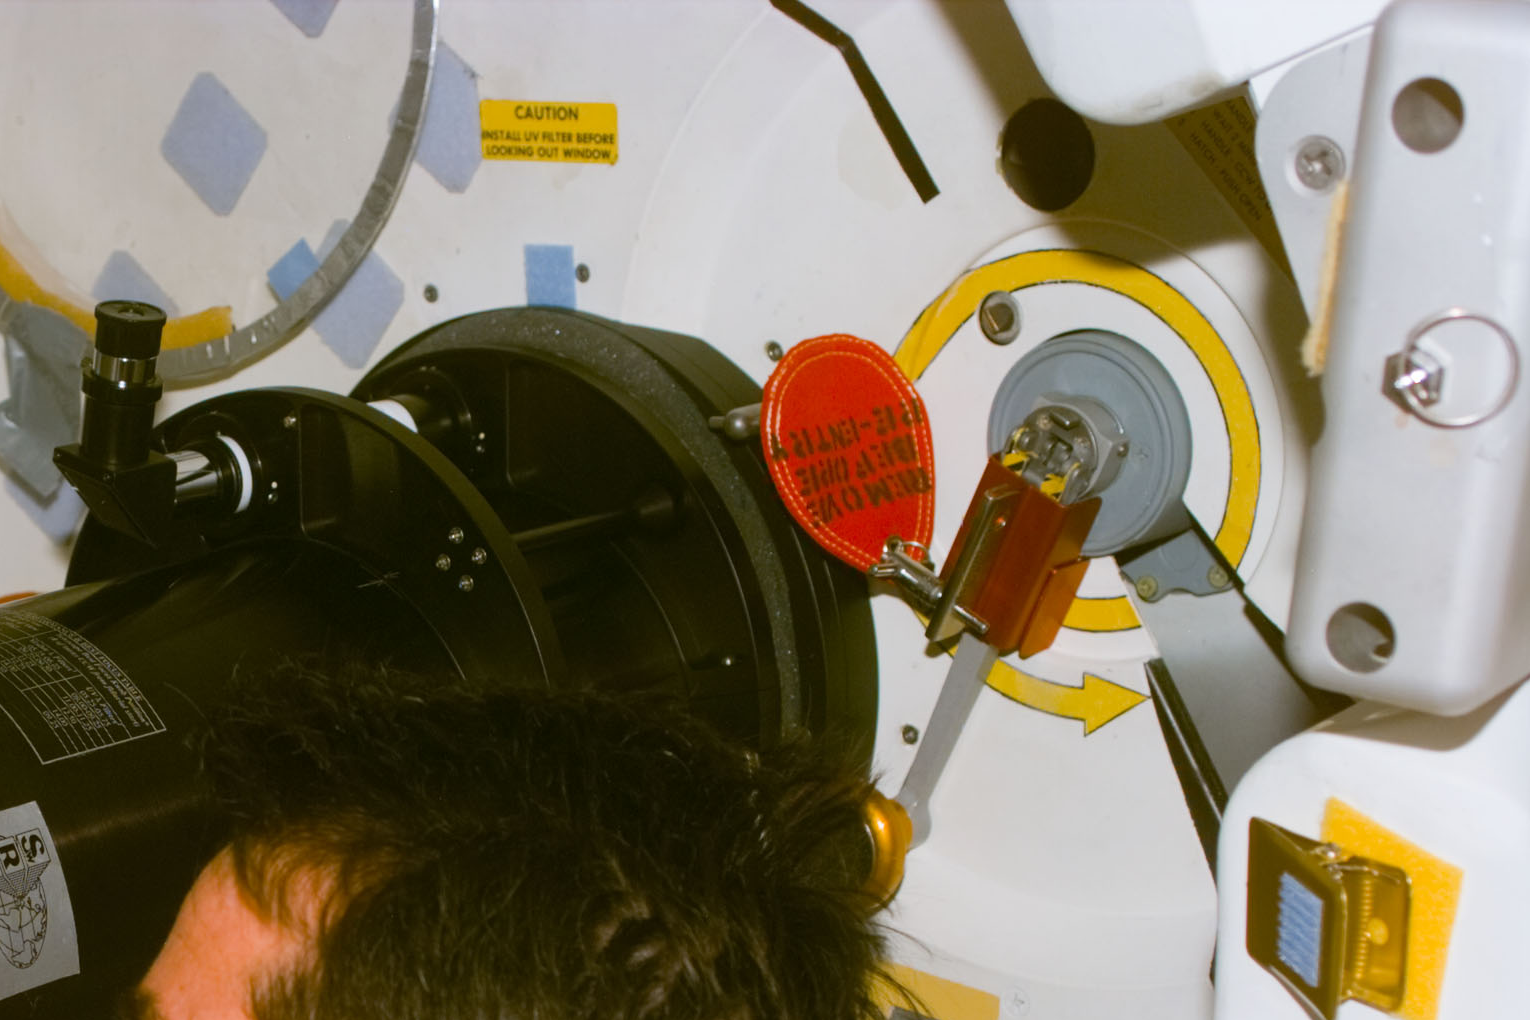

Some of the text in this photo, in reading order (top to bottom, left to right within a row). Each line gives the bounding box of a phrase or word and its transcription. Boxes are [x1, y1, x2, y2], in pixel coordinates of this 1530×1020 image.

[514, 105, 579, 121] CAUTION
[481, 130, 615, 145] INSTALL UV FILTER BEFORE
[486, 145, 611, 160] LOOKING OUT WINDOW
[1189, 132, 1216, 164] HATCH
[1239, 193, 1262, 221] OPEN
[770, 397, 923, 462] RE-ENTRY
[796, 433, 918, 497] BEFORE
[806, 466, 932, 527] REMOVE
[120, 679, 143, 703] TABLE
